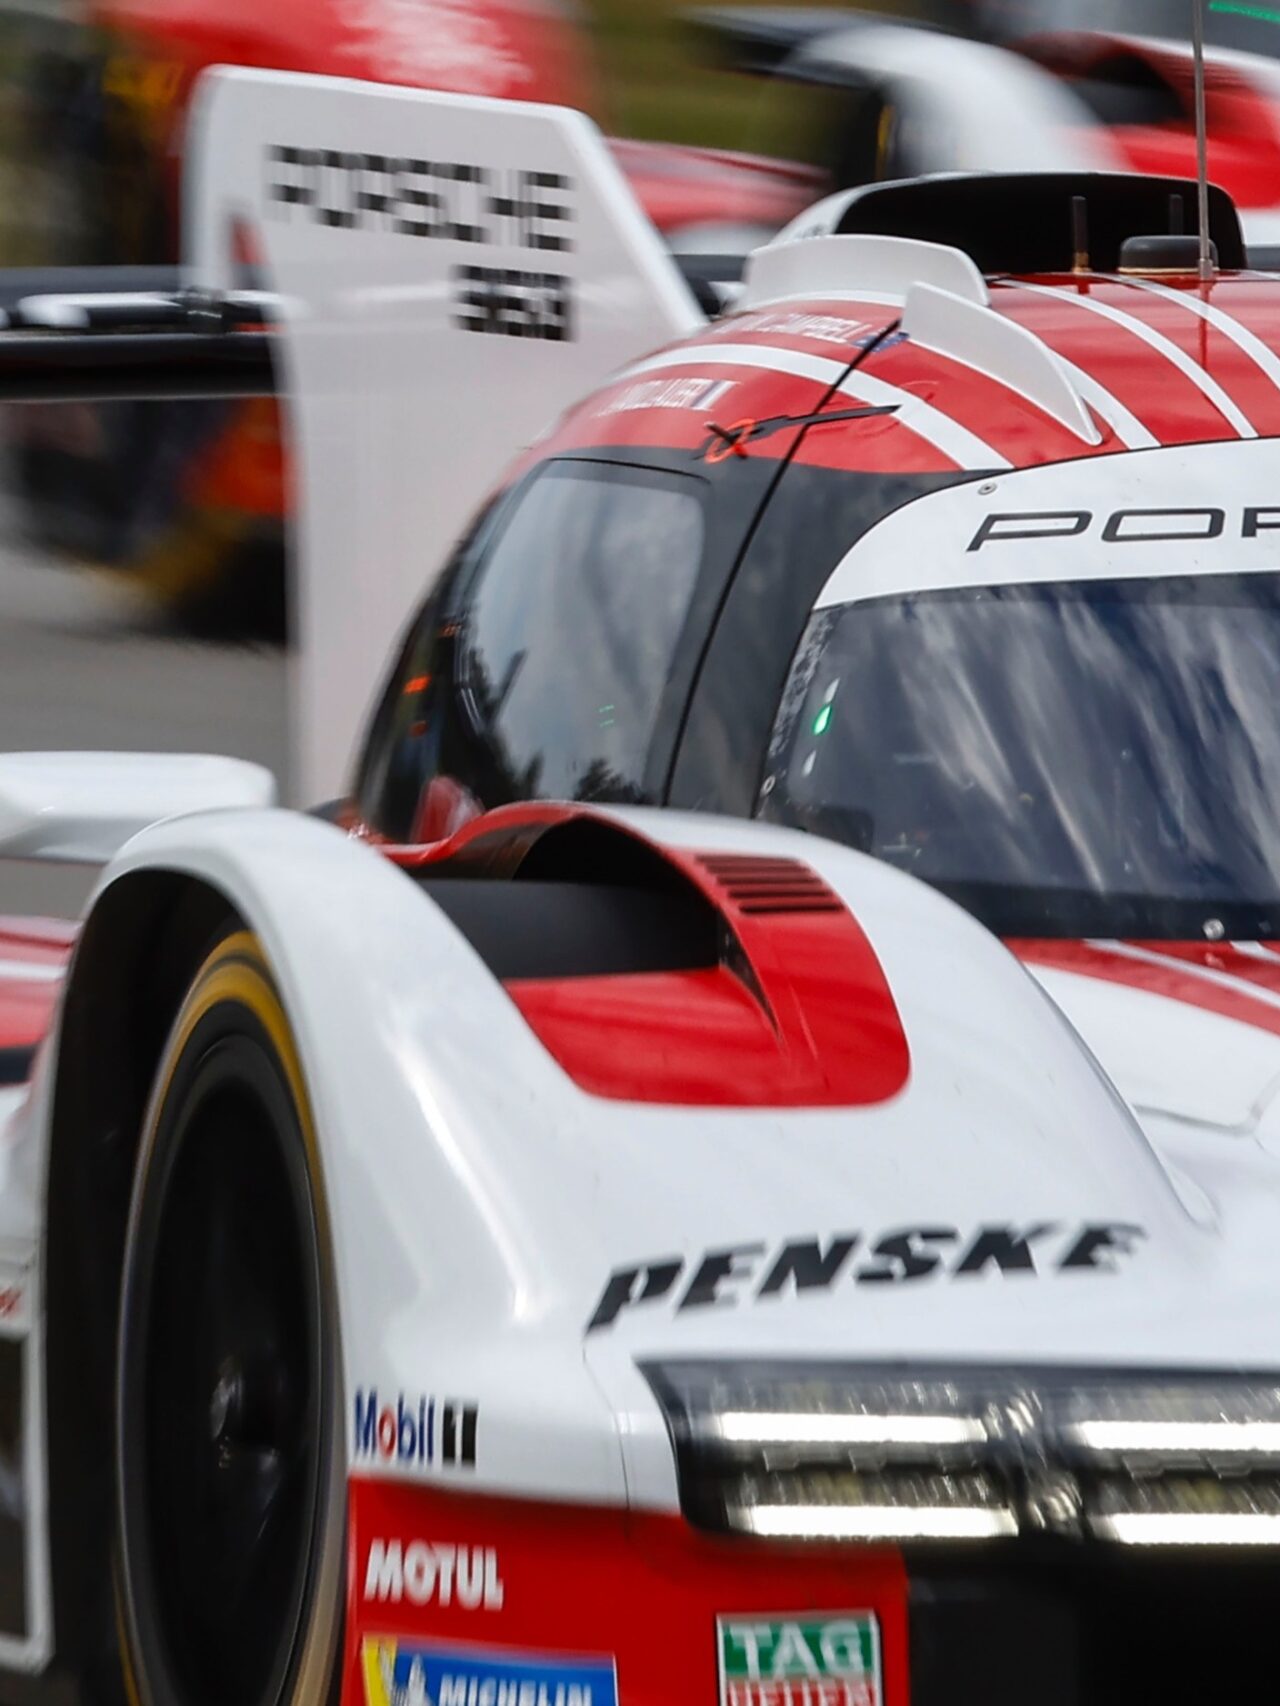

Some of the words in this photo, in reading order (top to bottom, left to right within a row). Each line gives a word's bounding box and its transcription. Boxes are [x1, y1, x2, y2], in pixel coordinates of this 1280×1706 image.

[266, 145, 575, 252] PORSCHE
[584, 1220, 1147, 1337] PENSKE
[354, 1387, 435, 1464] Mobil
[364, 1537, 503, 1612] MOTUL
[729, 1619, 865, 1679] TAG
